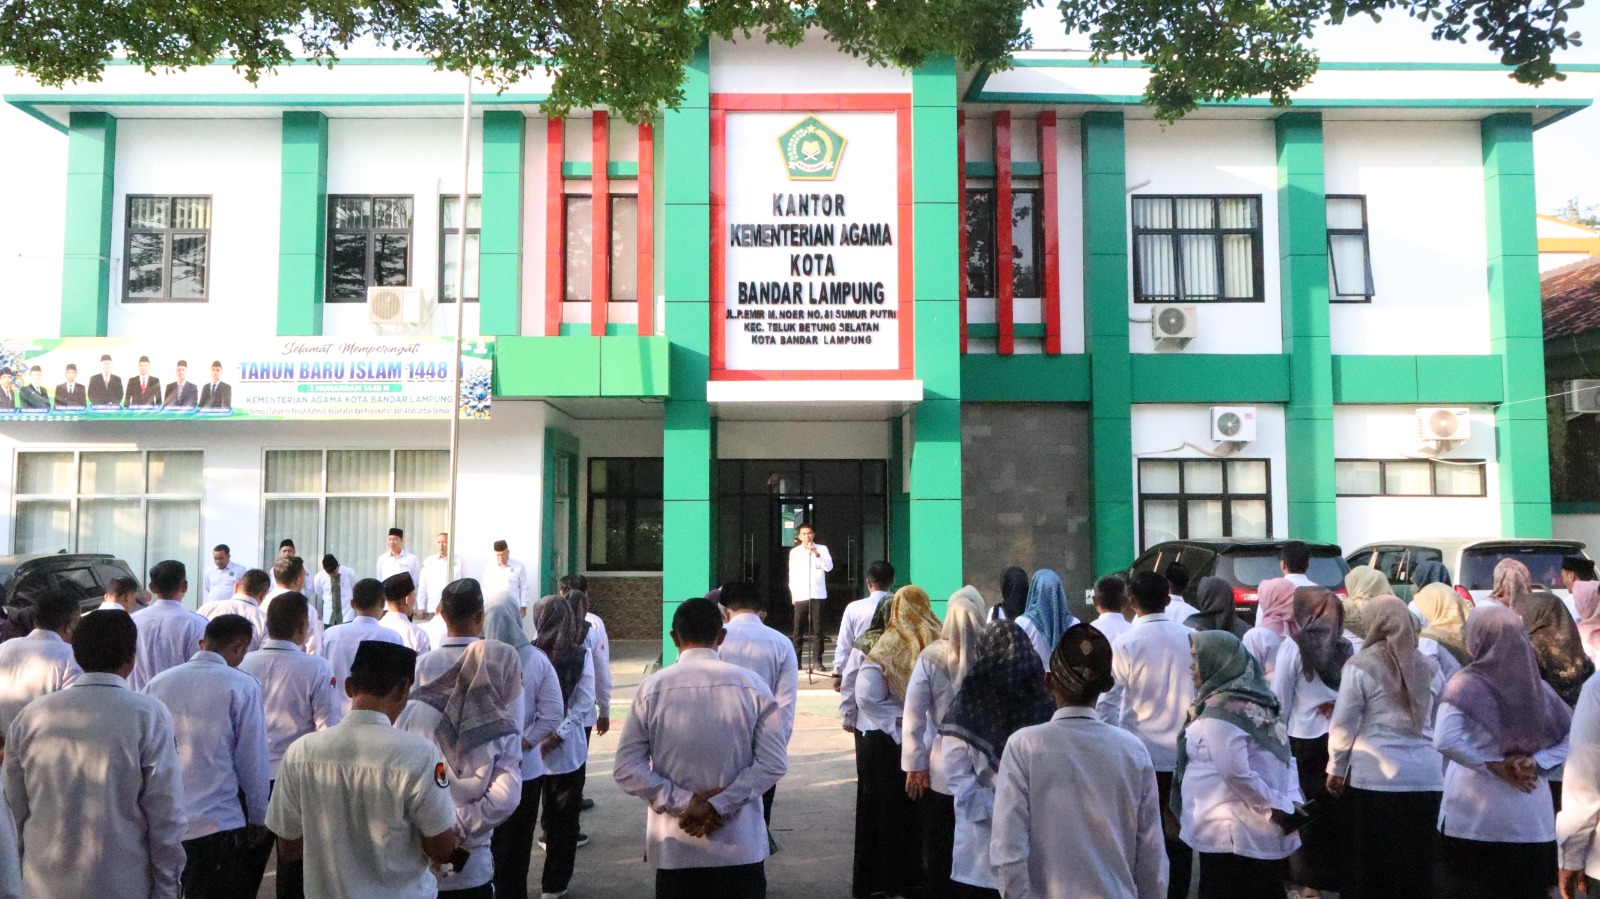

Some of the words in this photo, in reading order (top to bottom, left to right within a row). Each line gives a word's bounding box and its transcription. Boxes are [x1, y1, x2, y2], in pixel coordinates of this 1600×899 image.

[773, 193, 845, 217] KANTOR
[731, 223, 834, 247] KEMENTERIAN
[840, 223, 892, 246] AGAMA
[790, 253, 835, 276] KOTA
[738, 281, 803, 305] BANDAR
[809, 281, 885, 305] LAMPUNG
[835, 310, 867, 319] SUMUR
[870, 310, 897, 319] PUTRI
[744, 323, 764, 332] KEC.
[768, 323, 796, 332] TELUK
[798, 323, 836, 332] BETUNG
[839, 323, 879, 332] SELATAN
[751, 335, 776, 344] KOTA
[780, 335, 819, 344] BANDAR
[824, 335, 872, 344] LAMPUNG
[282, 341, 335, 355] Selamat
[339, 342, 420, 356] Memperingati
[240, 361, 294, 379] TAHUN
[299, 361, 345, 379] BARU
[350, 361, 402, 379] ISLAM
[407, 361, 448, 379] 1448
[315, 384, 362, 392] MUHARRAM
[246, 396, 308, 404] KEMENTERIAN
[311, 396, 342, 404] AGAMA
[345, 396, 368, 404] KOTA
[371, 396, 407, 404] BANDAR
